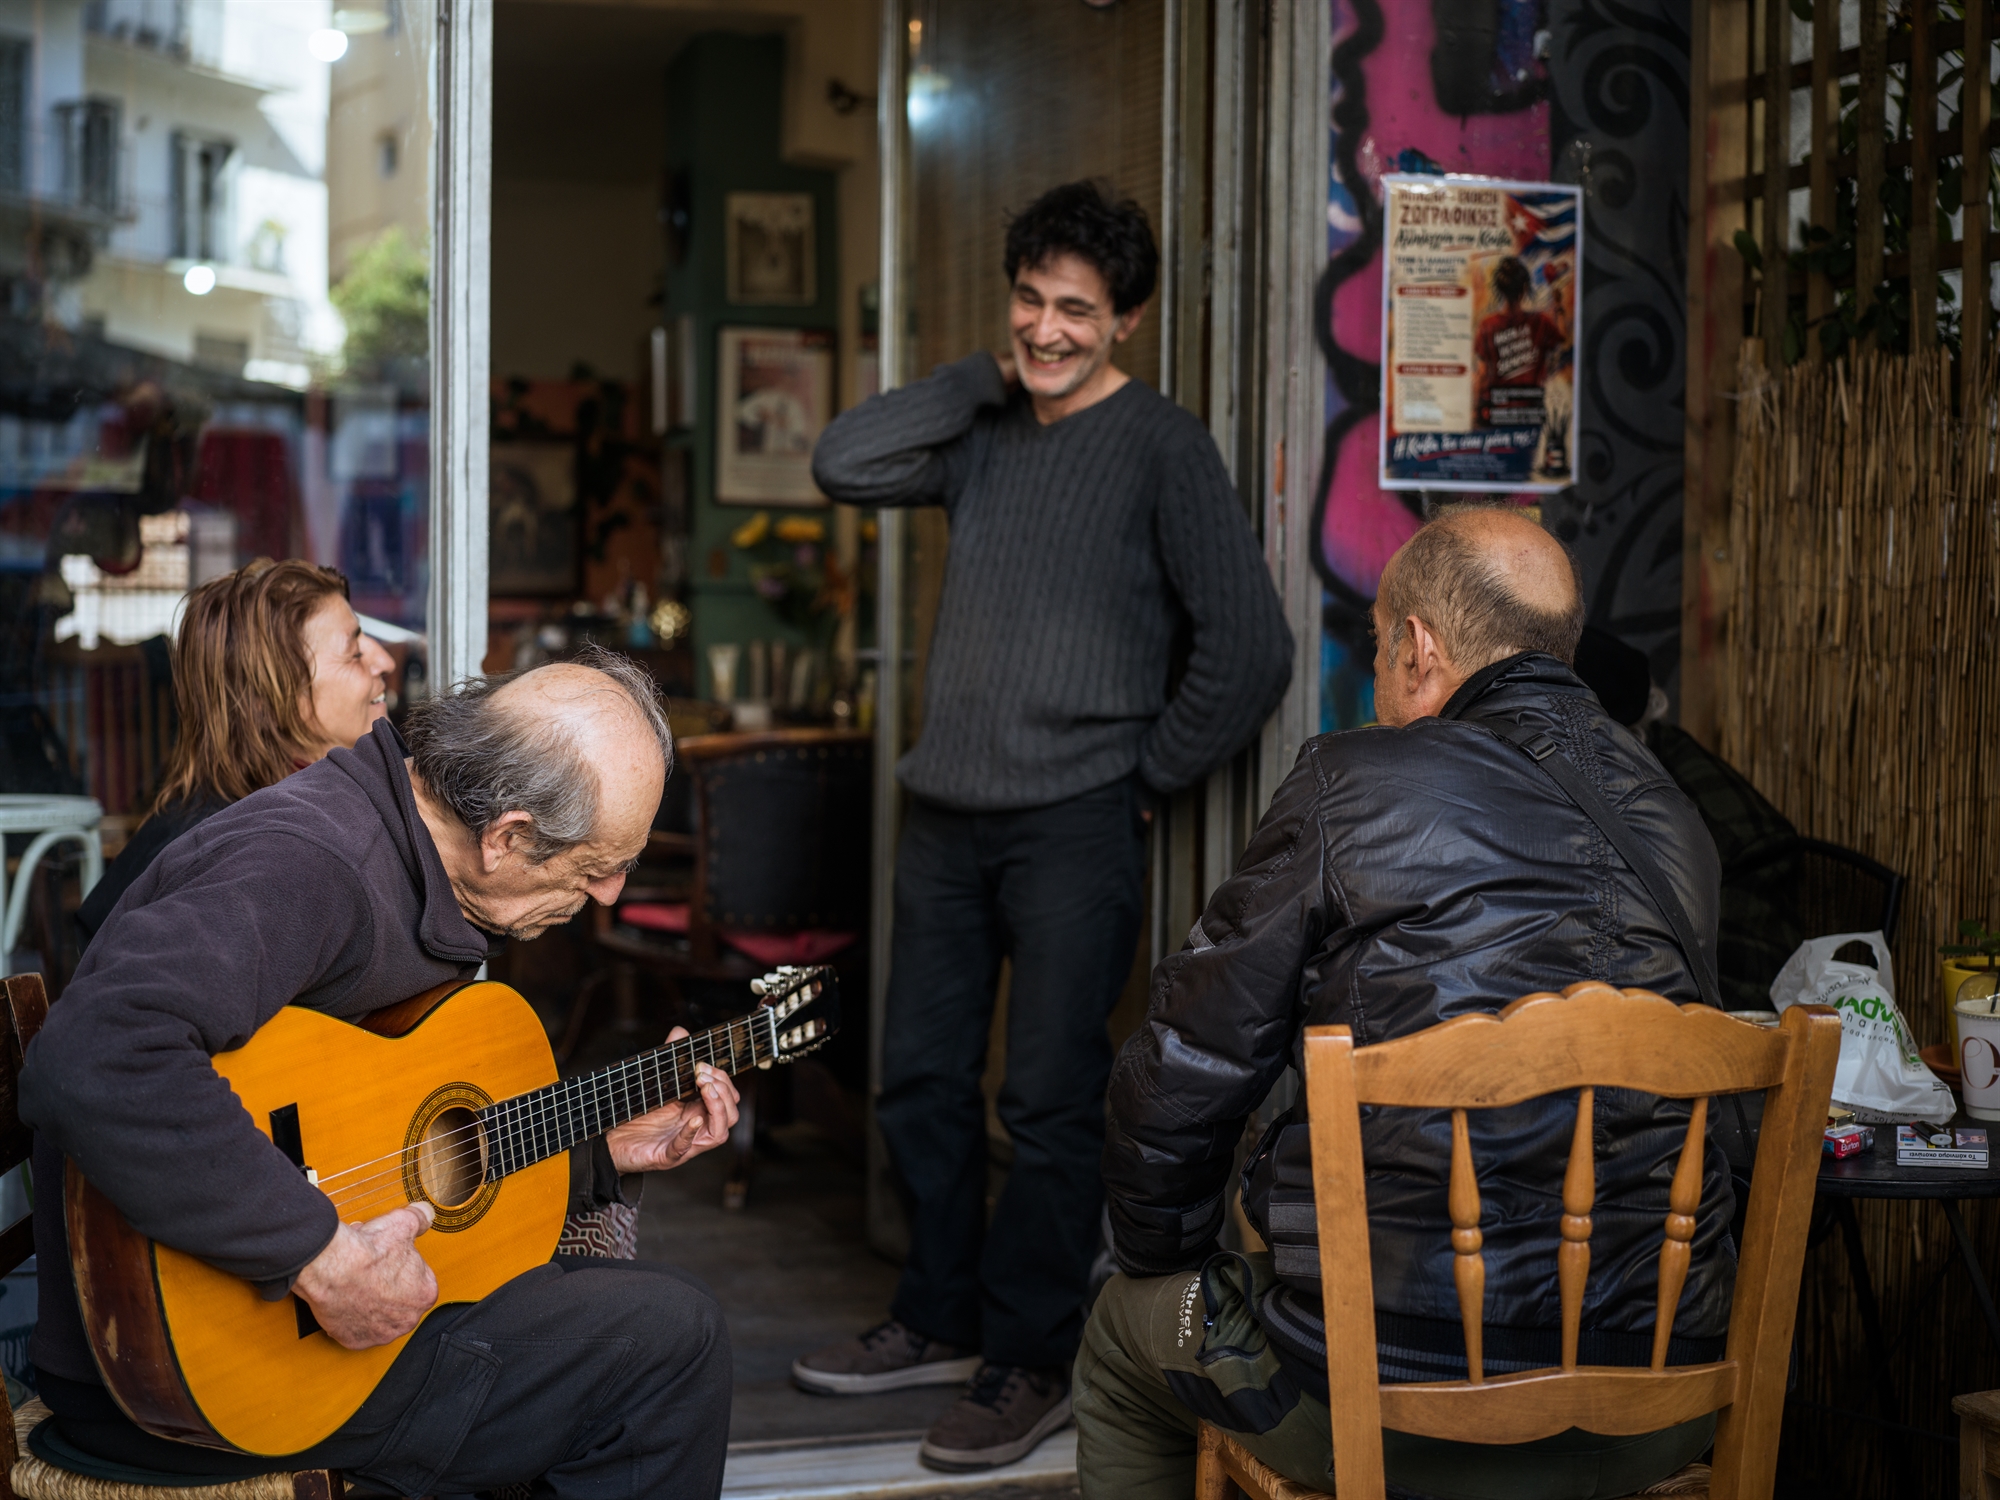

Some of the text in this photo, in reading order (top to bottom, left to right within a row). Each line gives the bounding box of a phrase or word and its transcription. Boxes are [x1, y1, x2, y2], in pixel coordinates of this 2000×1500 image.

[1400, 205, 1497, 227] ΖΩΓΡΑΦΙΚΗΣ
[1840, 1141, 1860, 1153] Burton
[1909, 1152, 1937, 1160] σκοτώνει
[1938, 1152, 1967, 1160] κάπνισμα
